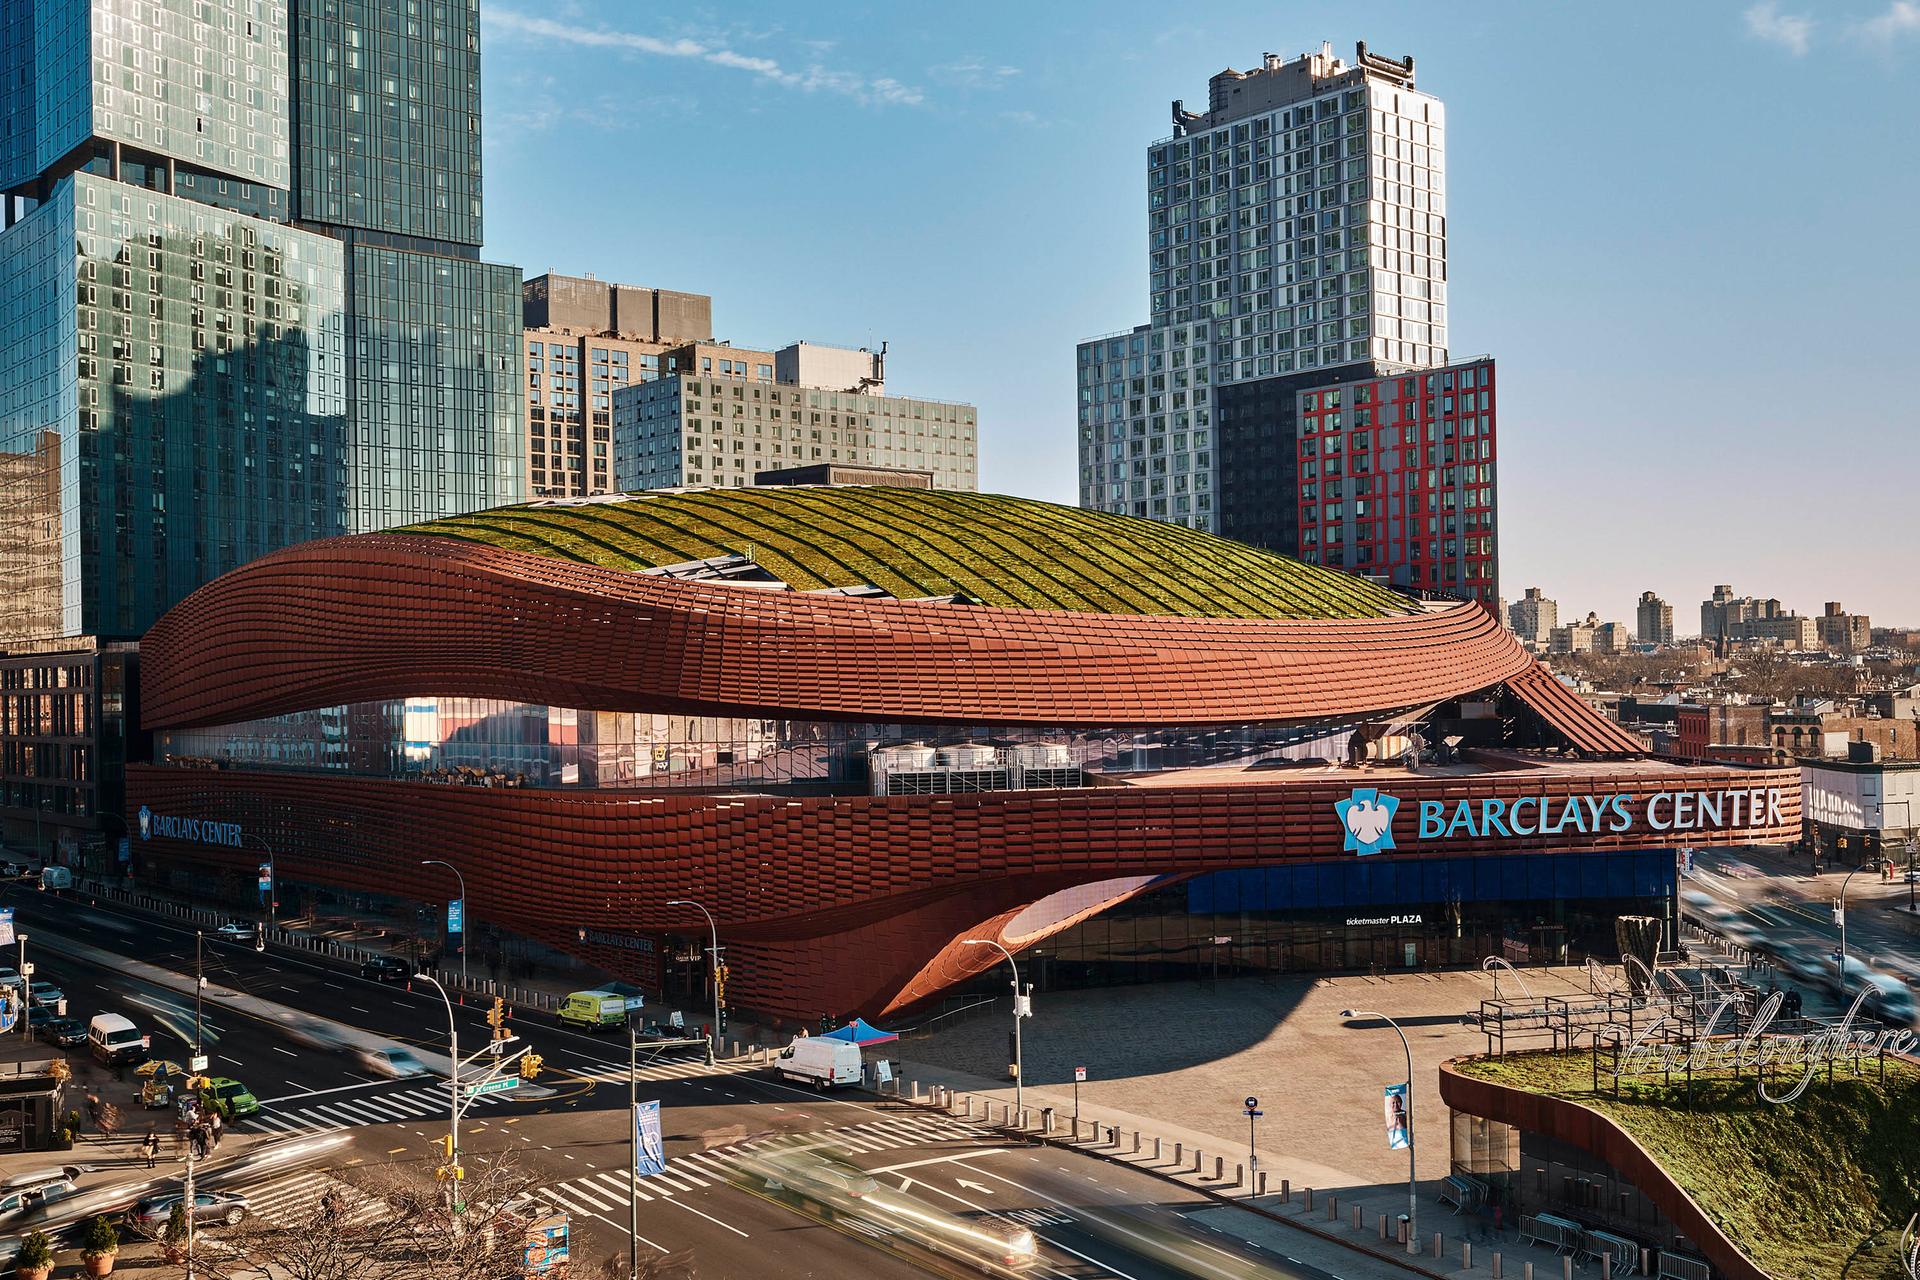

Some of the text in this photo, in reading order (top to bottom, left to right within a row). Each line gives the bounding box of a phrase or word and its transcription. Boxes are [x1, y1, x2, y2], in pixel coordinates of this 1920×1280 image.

[1418, 788, 1786, 839] BARCLAYS CENTER
[153, 815, 242, 848] BARCLAYS CENTER
[1346, 914, 1422, 926] ticketmaster PLAZA
[624, 935, 654, 952] CENTER
[1828, 983, 1919, 1061] here
[1007, 1206, 1080, 1226] ONLY
